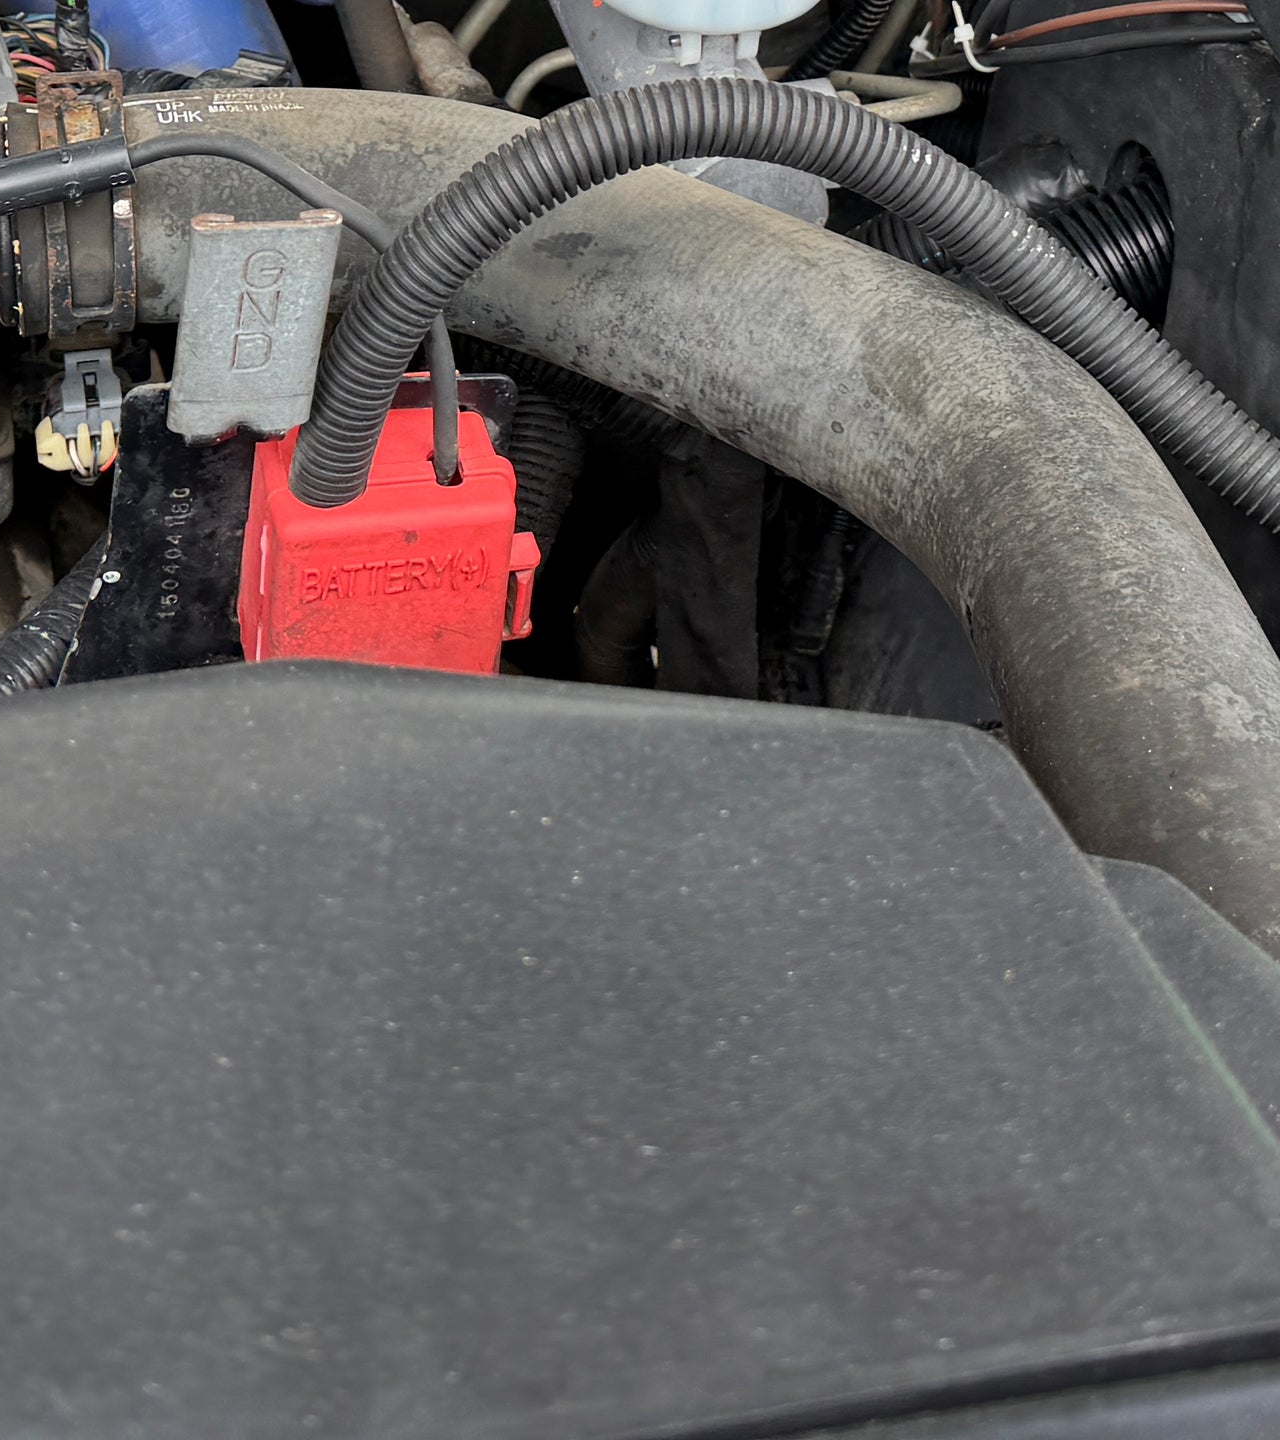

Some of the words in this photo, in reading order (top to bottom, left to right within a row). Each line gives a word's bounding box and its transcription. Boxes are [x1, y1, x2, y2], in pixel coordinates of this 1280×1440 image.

[155, 101, 185, 112] UP
[156, 110, 204, 124] UHK
[231, 248, 287, 374] GND
